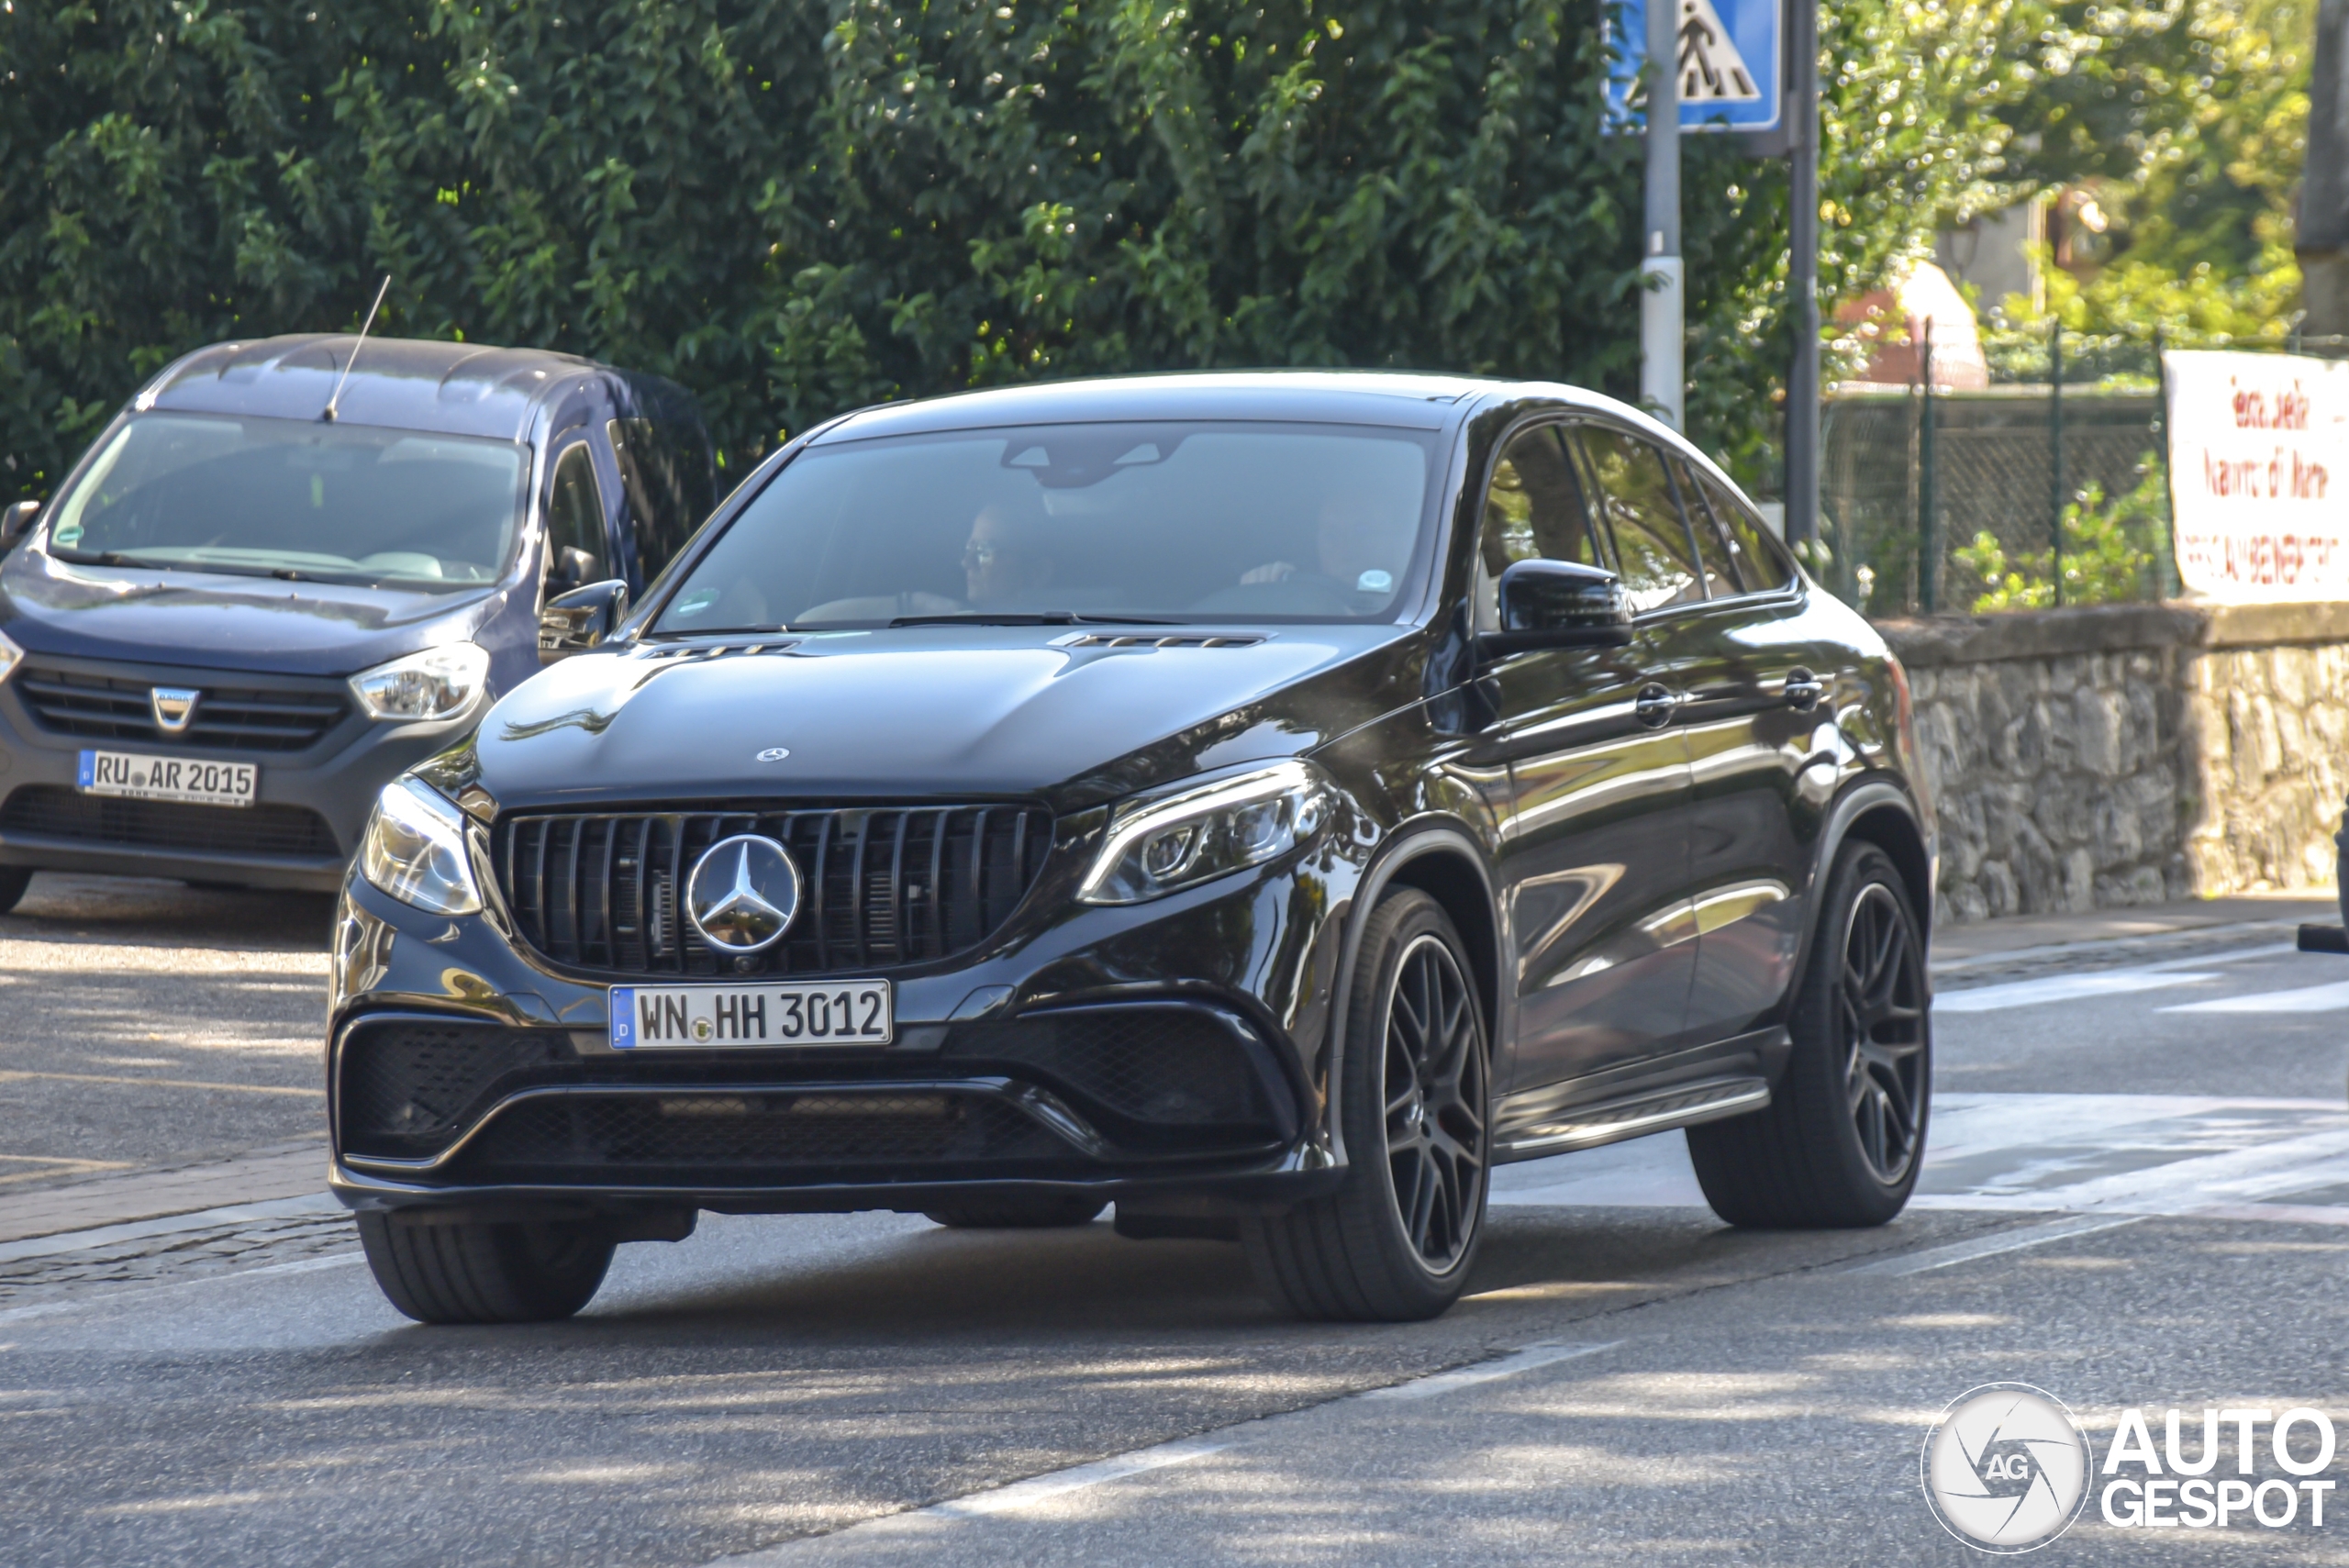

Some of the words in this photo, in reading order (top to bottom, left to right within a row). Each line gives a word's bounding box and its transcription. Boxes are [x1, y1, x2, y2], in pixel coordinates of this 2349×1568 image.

[96, 756, 129, 784] RU
[150, 761, 182, 790] AR
[187, 763, 251, 795] 2015
[618, 1023, 629, 1037] D
[640, 994, 688, 1040] WN
[715, 994, 766, 1039] HH
[780, 990, 884, 1038] 3012
